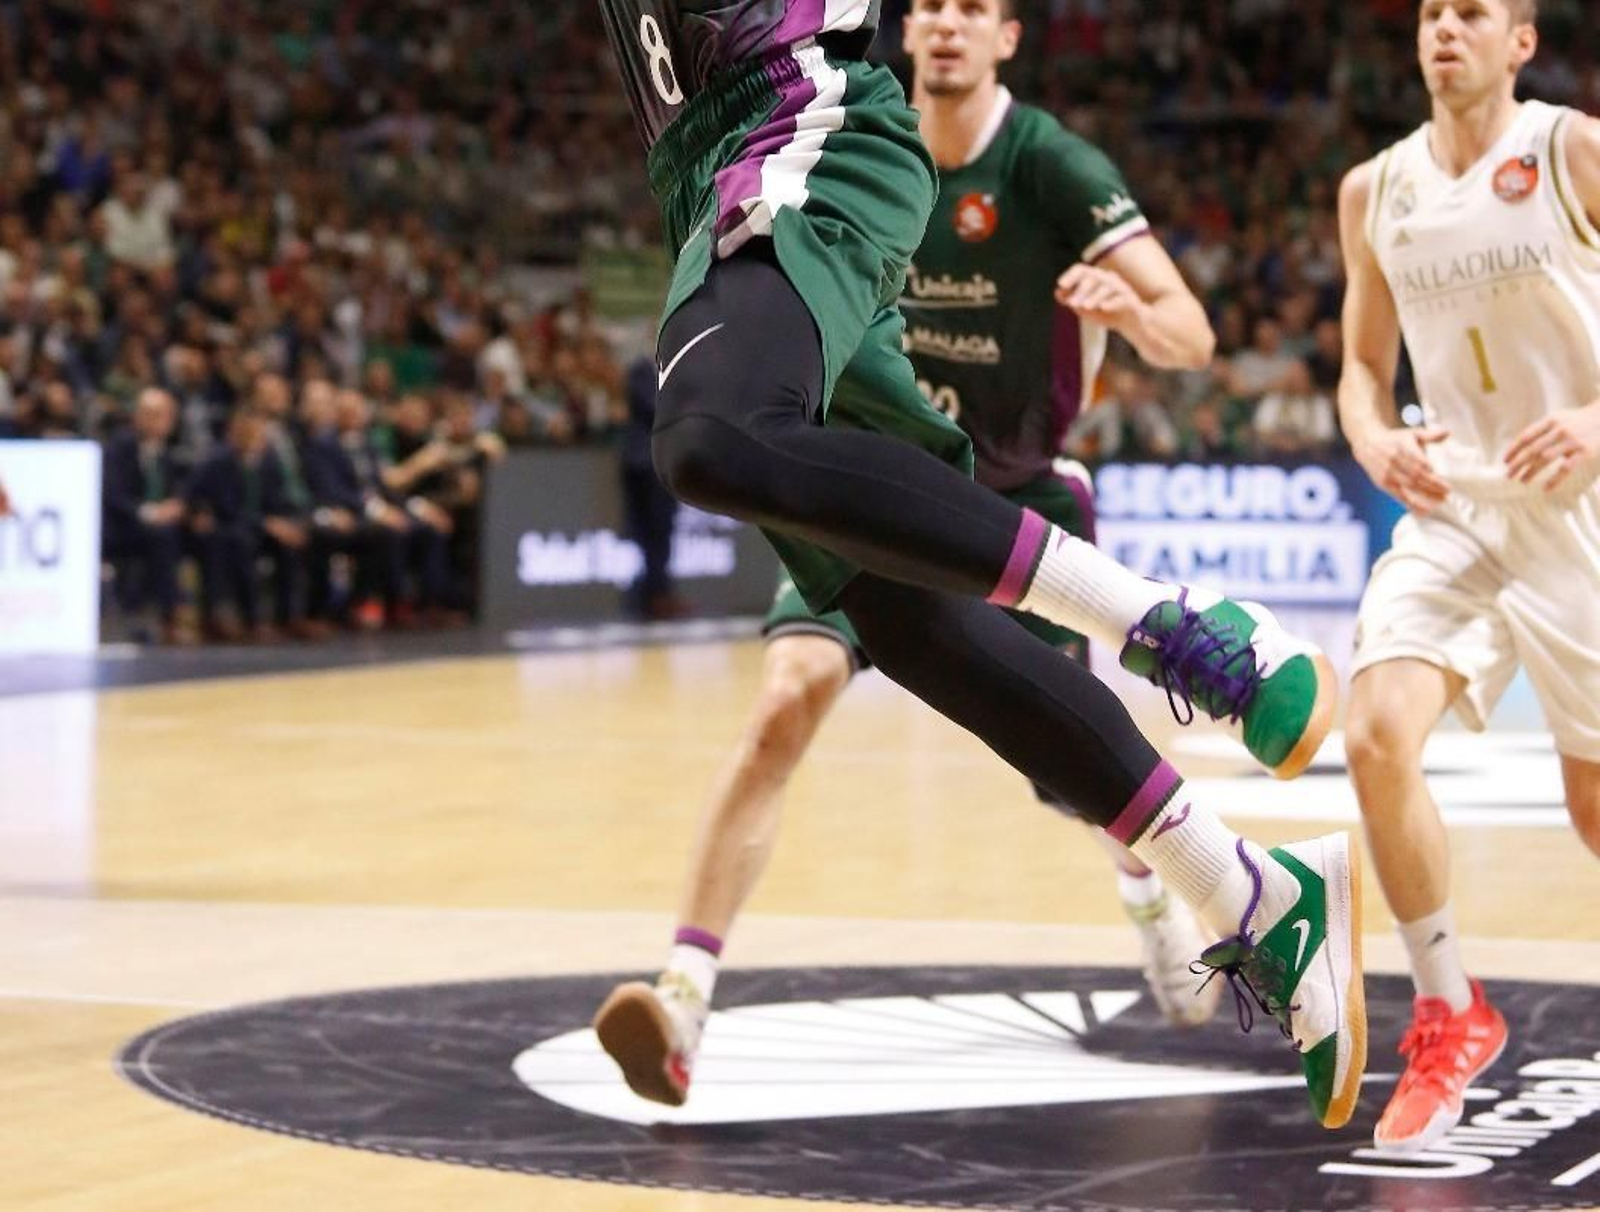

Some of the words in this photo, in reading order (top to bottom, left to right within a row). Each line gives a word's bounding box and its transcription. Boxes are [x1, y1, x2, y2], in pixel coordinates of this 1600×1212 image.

[640, 14, 684, 105] 8
[1396, 242, 1552, 290] ALLADIUM
[1466, 326, 1497, 393] 1
[1114, 543, 1338, 582] FAMILIA
